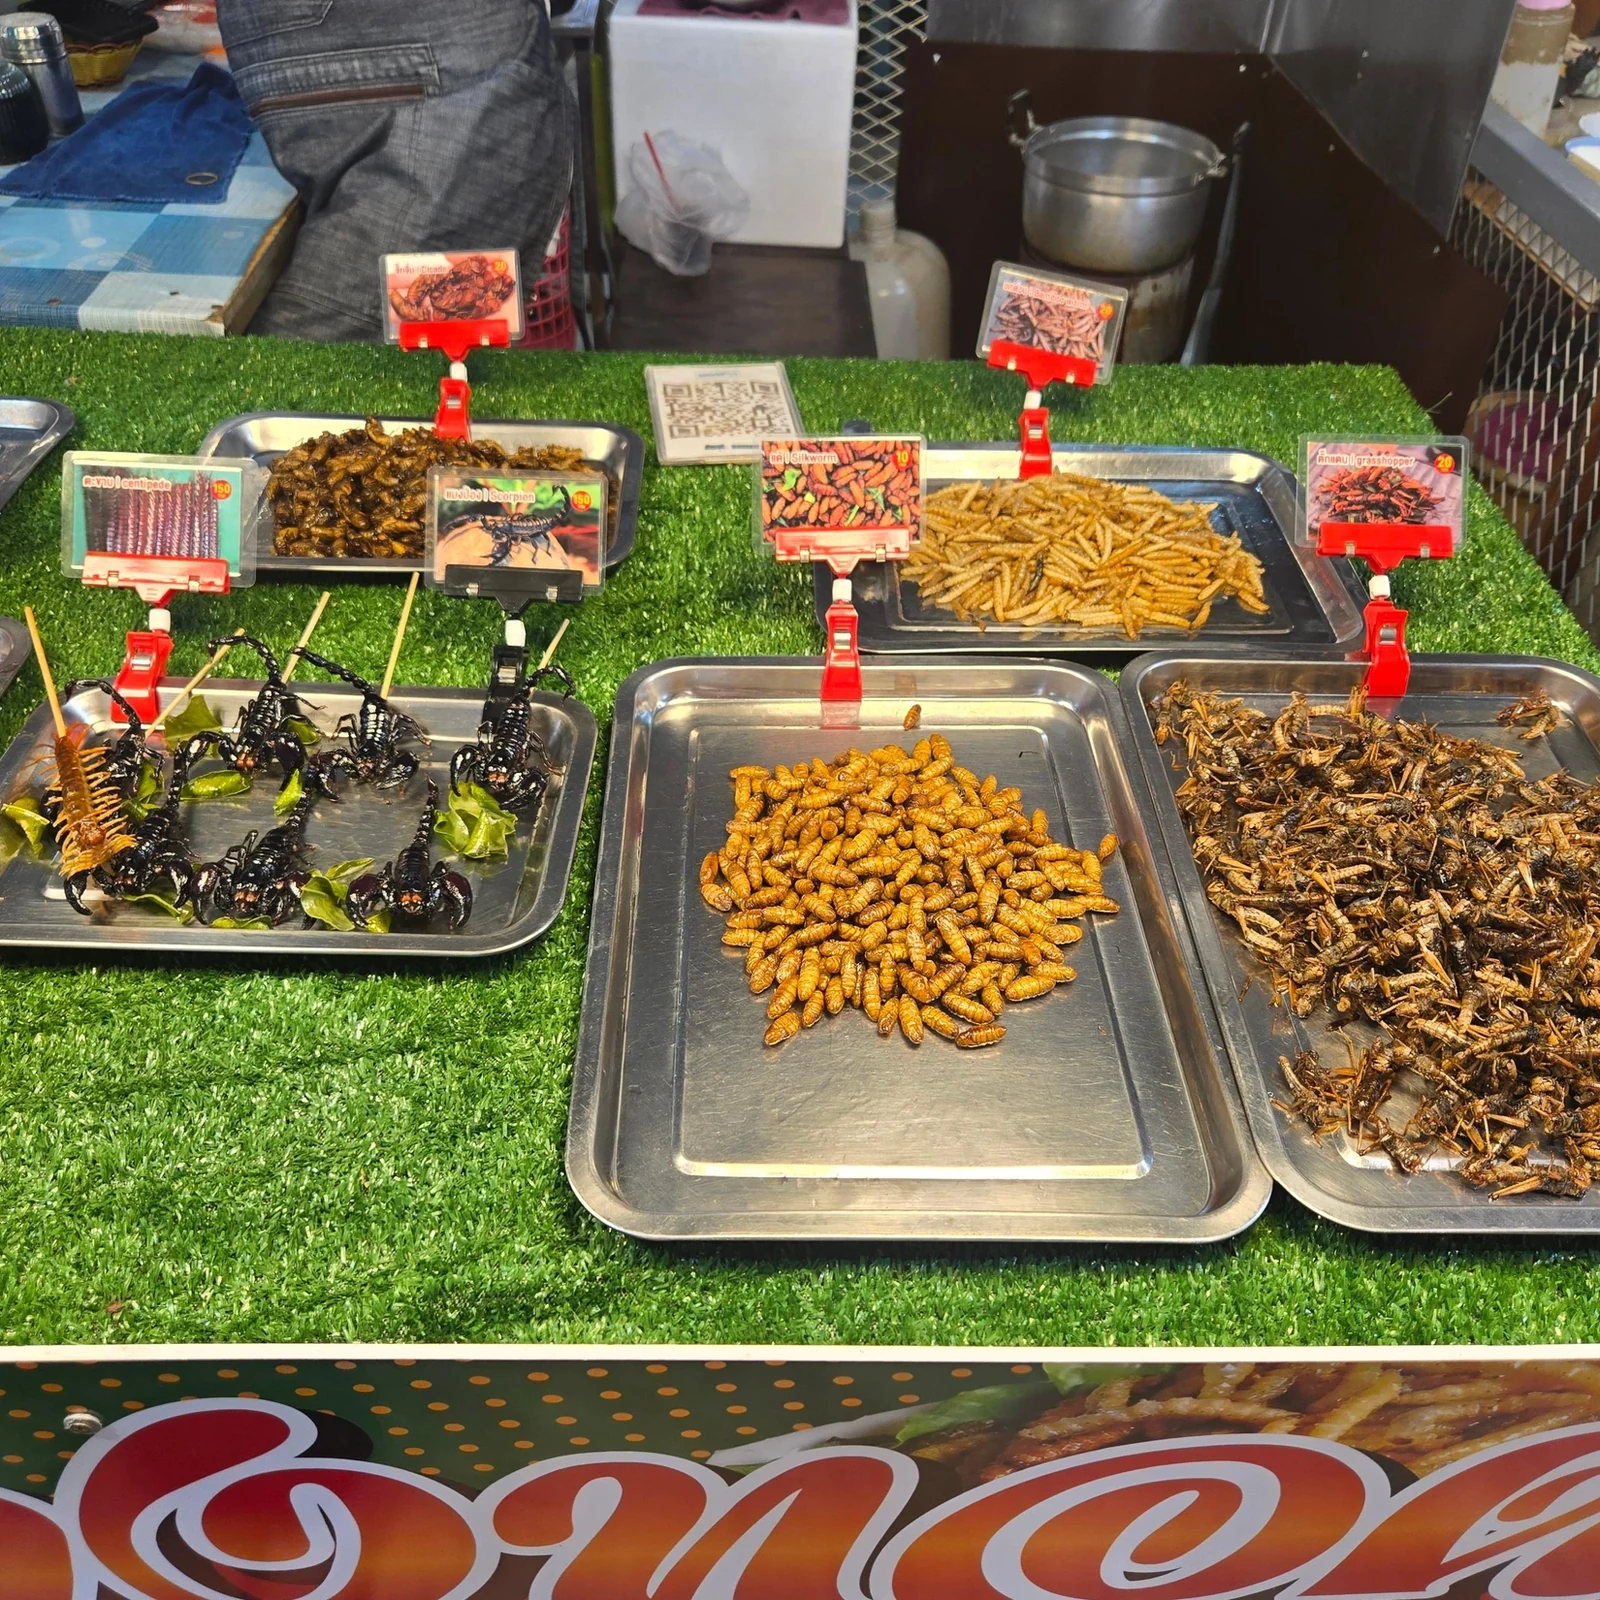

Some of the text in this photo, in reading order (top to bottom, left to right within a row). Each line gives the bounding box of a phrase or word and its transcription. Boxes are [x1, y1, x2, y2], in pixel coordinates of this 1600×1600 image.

[494, 261, 506, 271] 20
[791, 453, 837, 463] Silkworm
[896, 452, 908, 462] 10
[1357, 455, 1414, 467] grasshopper
[1437, 457, 1452, 468] 20
[123, 478, 171, 491] centipede
[212, 484, 231, 493] 150
[490, 489, 535, 503] Scorpion
[573, 495, 590, 504] 150
